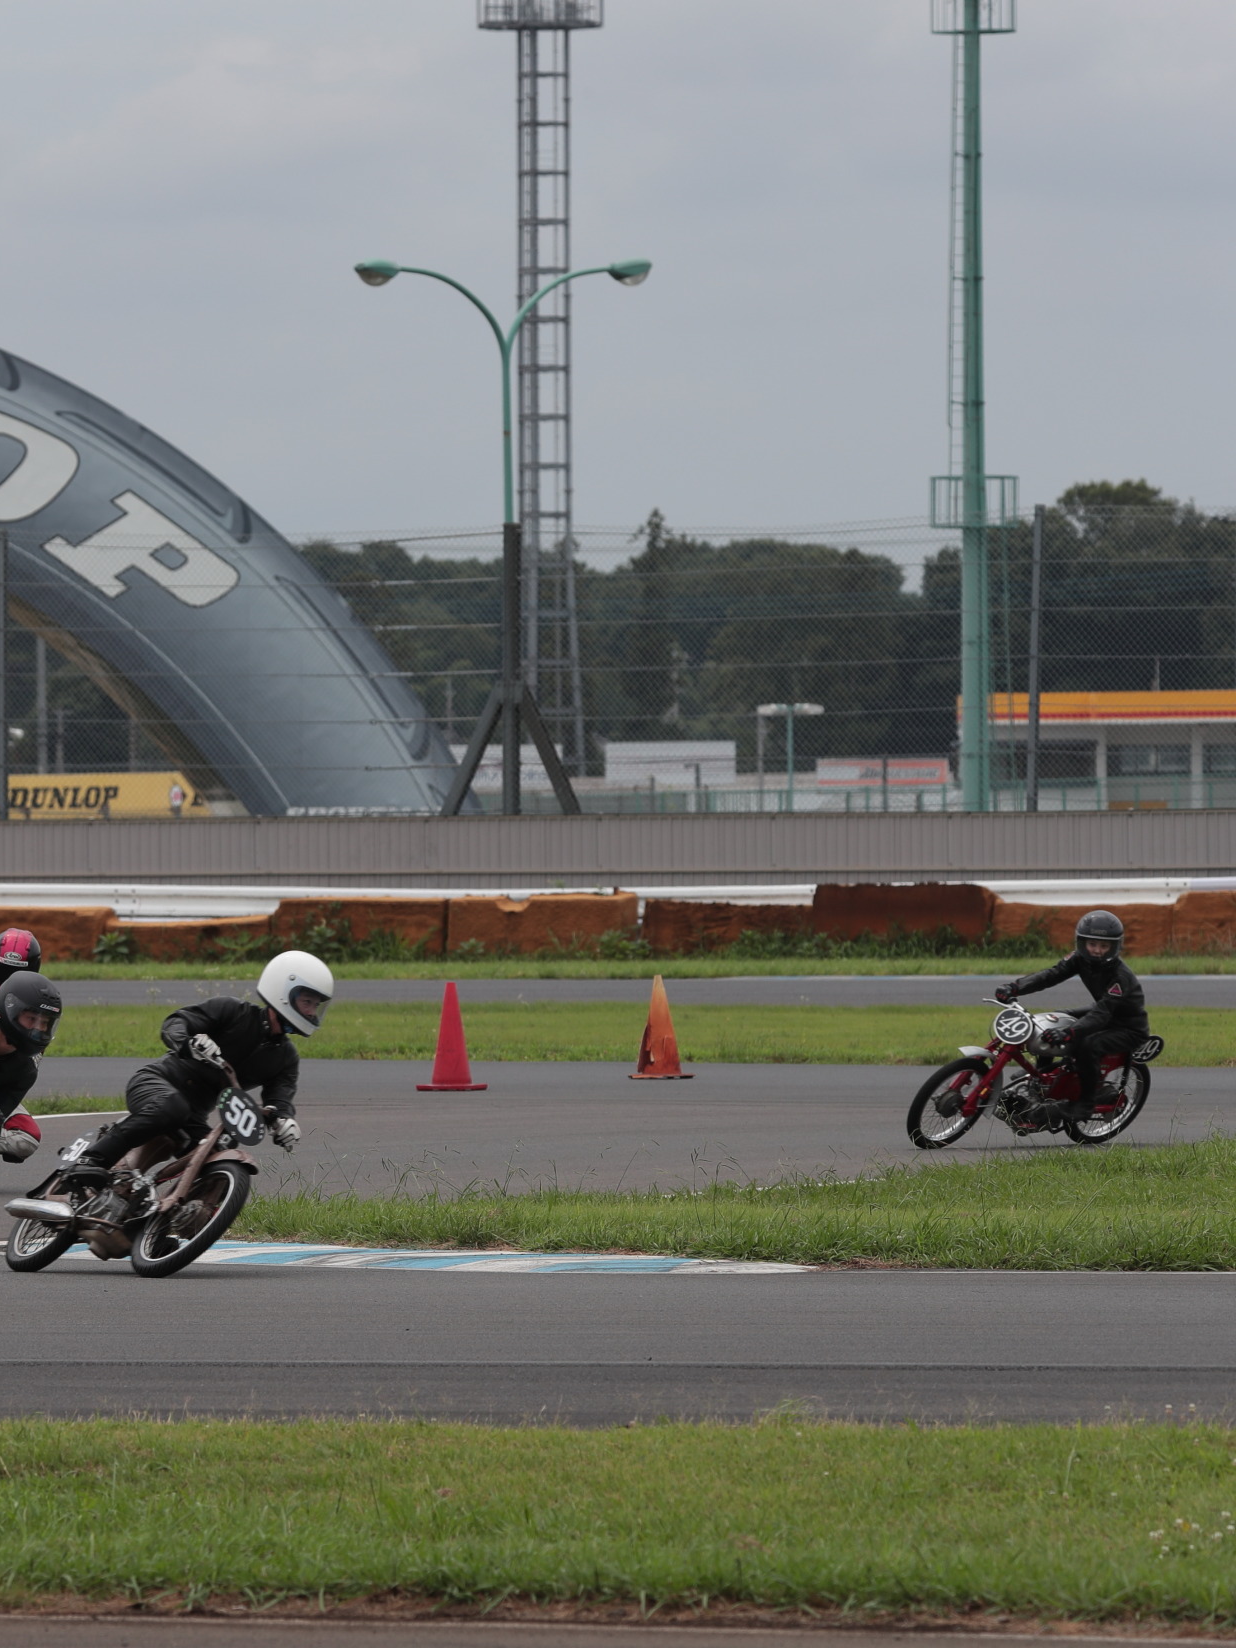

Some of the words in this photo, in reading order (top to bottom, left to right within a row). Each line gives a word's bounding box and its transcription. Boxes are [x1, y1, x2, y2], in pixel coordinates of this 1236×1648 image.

[8, 786, 119, 810] DUNLOP
[997, 1015, 1029, 1038] 49
[1134, 1039, 1161, 1060] 49
[225, 1096, 258, 1138] 50
[62, 1137, 90, 1162] 50
